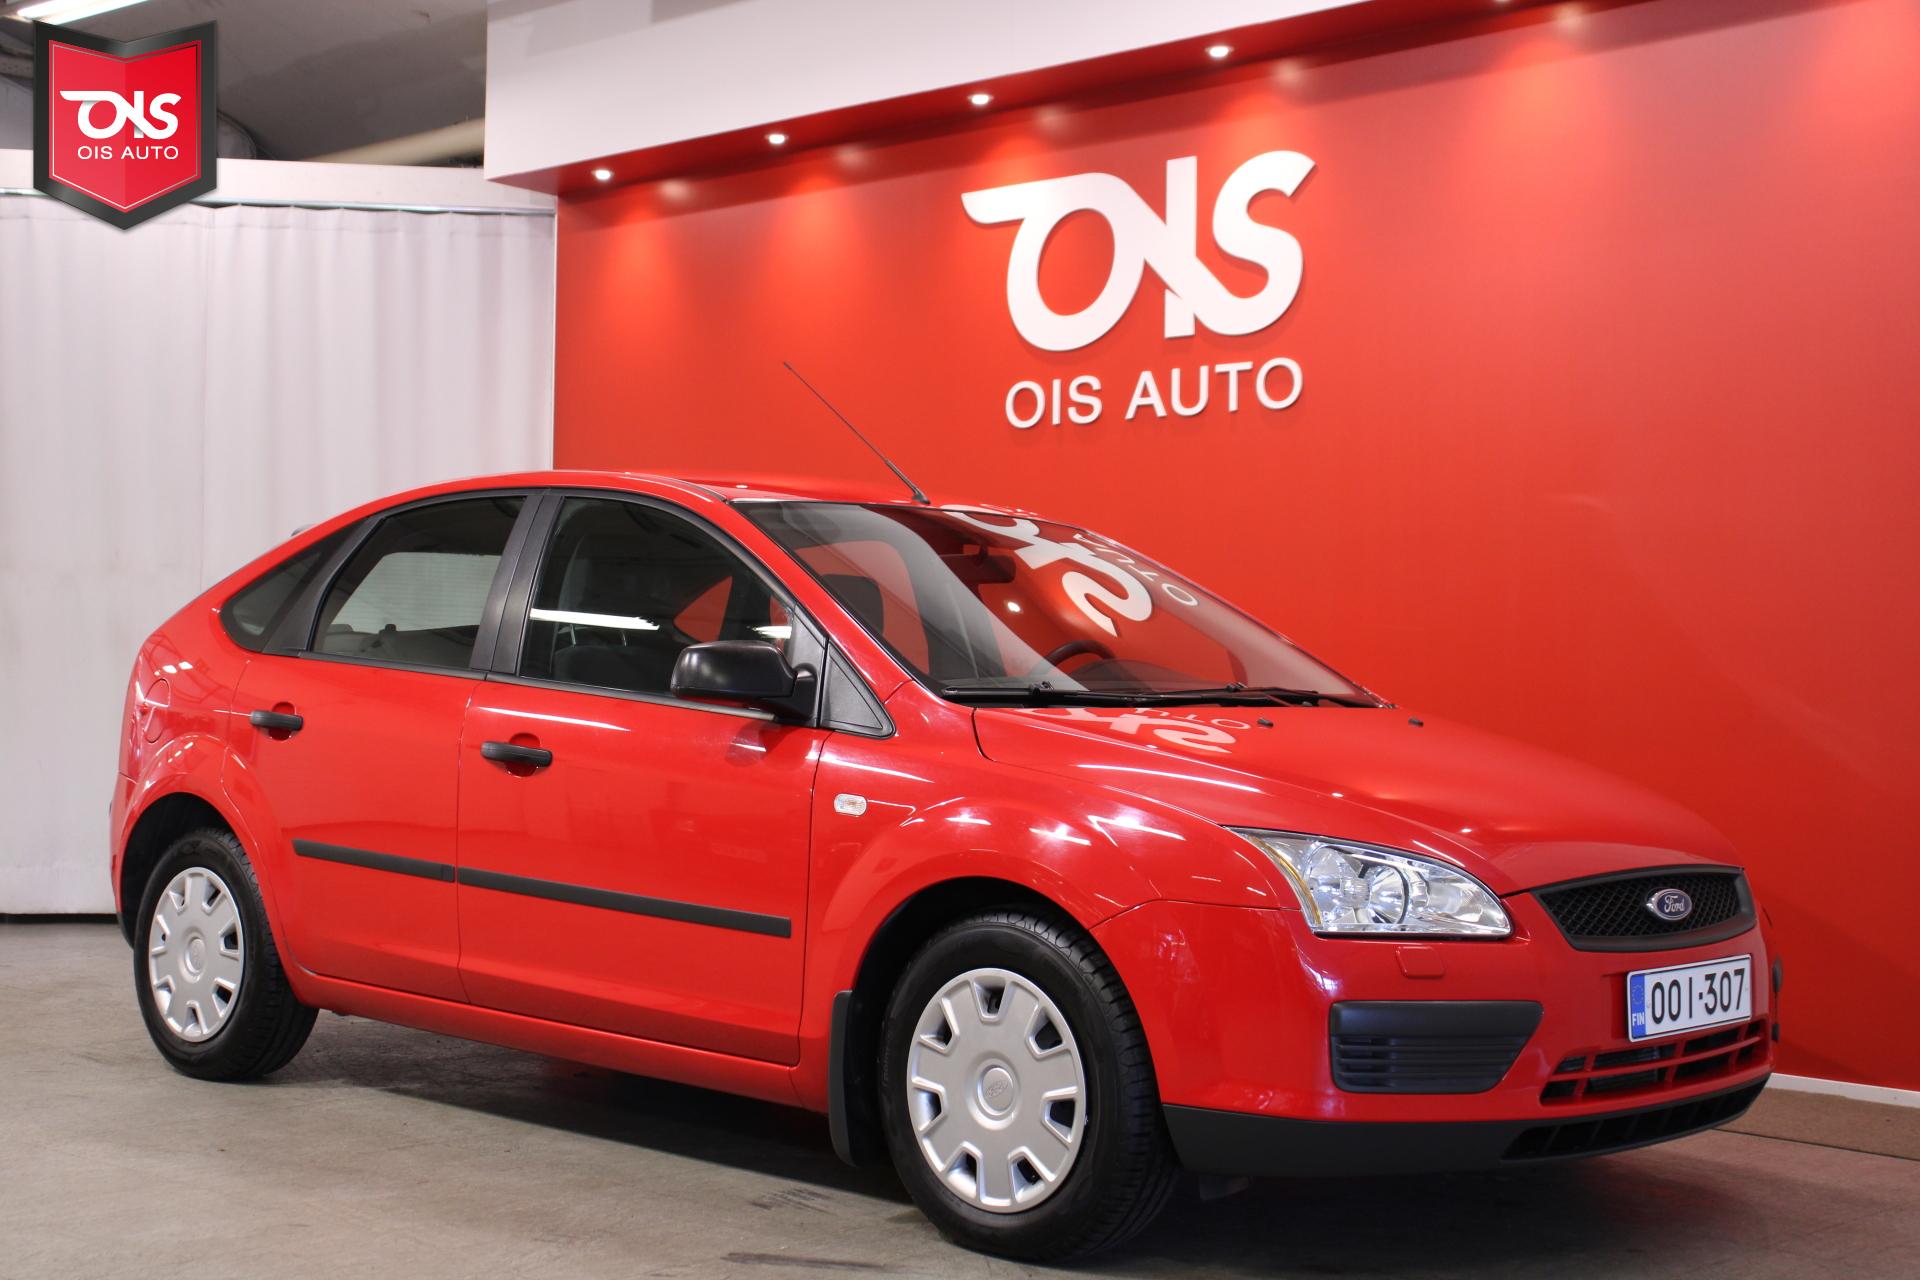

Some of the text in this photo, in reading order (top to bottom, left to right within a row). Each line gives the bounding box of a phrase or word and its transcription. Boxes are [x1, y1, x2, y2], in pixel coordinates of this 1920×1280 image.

[961, 150, 1316, 352] OIS
[1005, 357, 1303, 429] OIS AUTO
[1664, 895, 1685, 912] Ford
[1632, 1012, 1645, 1027] FIN
